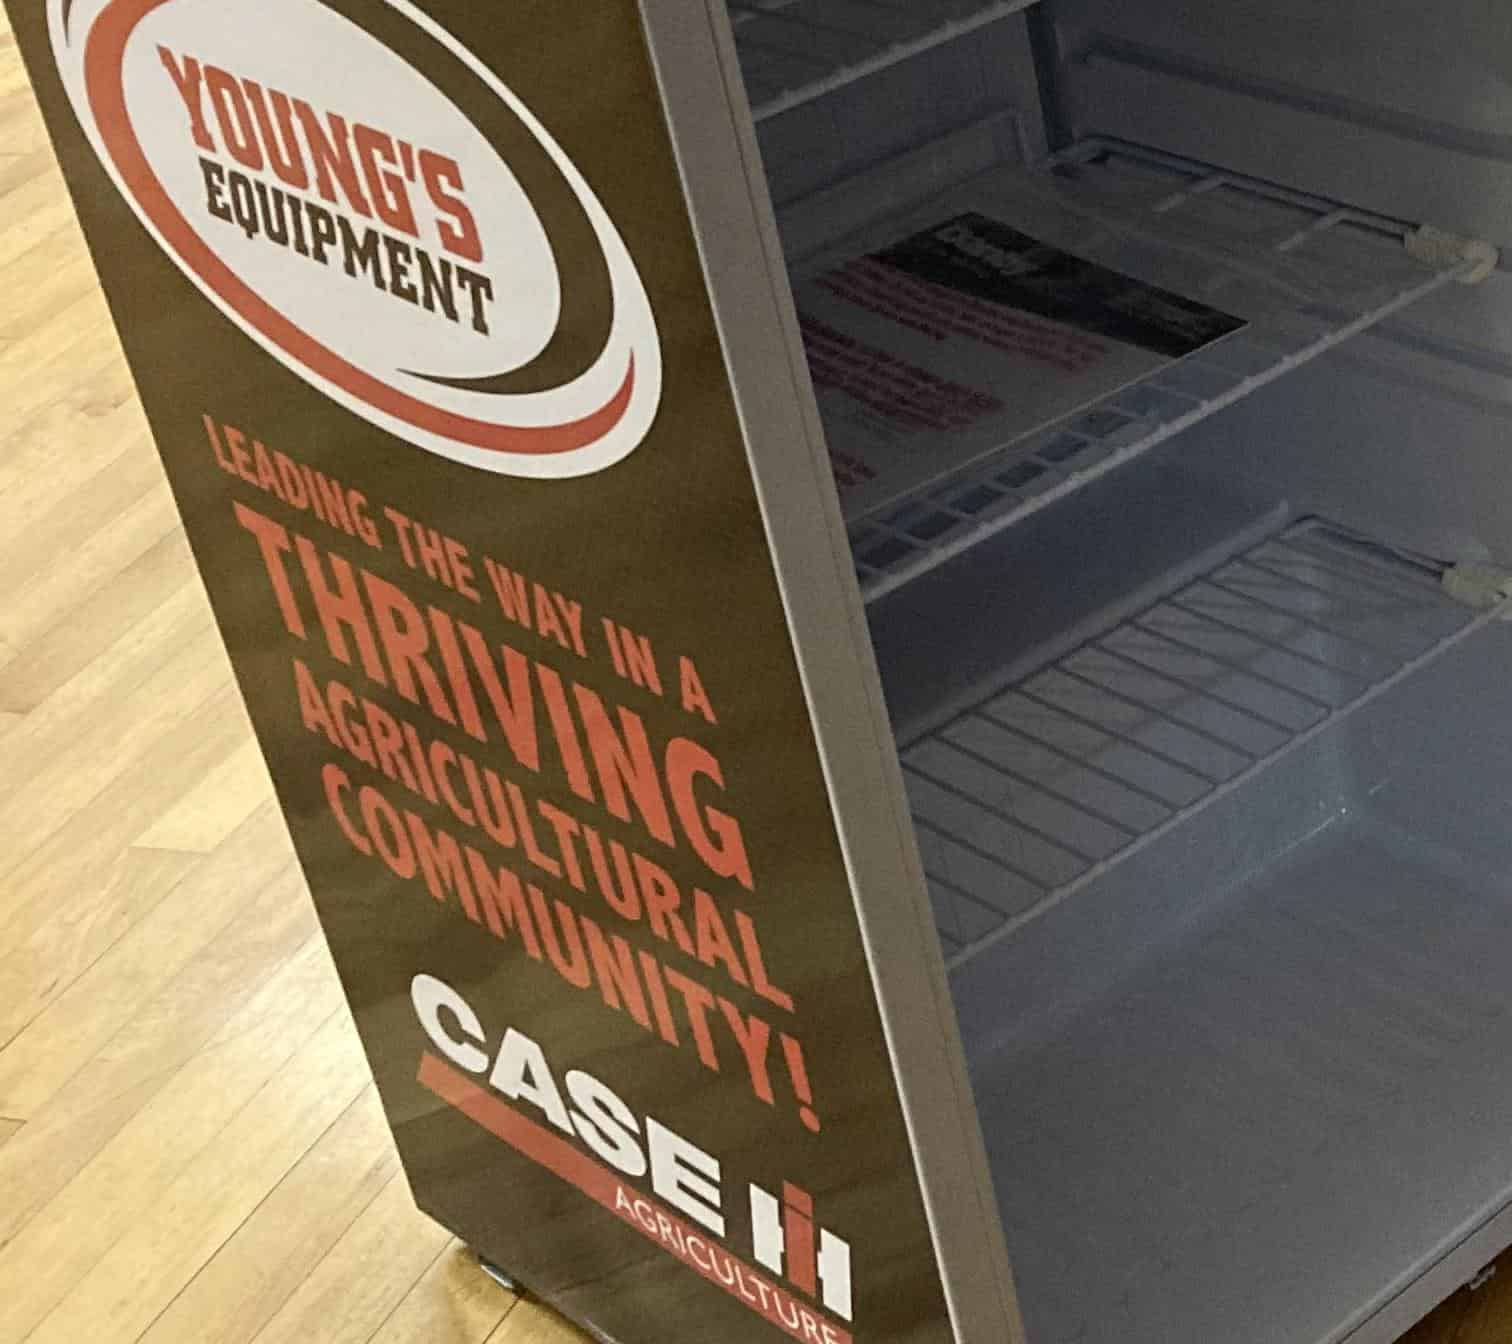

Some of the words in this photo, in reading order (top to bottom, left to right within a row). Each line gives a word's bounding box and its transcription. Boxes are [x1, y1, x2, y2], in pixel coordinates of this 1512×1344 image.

[156, 43, 484, 264] YOUNG'S
[198, 155, 495, 337] EQUIPMENT
[203, 413, 382, 550] LEADING
[384, 505, 481, 603] THE
[484, 556, 588, 658] WAY
[602, 616, 663, 697] IN
[679, 655, 719, 725] A
[232, 500, 755, 892] THRIVING
[294, 659, 796, 1013] AGRICULTURAL
[321, 762, 822, 1134] COMMUNITY!
[409, 973, 726, 1239] CASE
